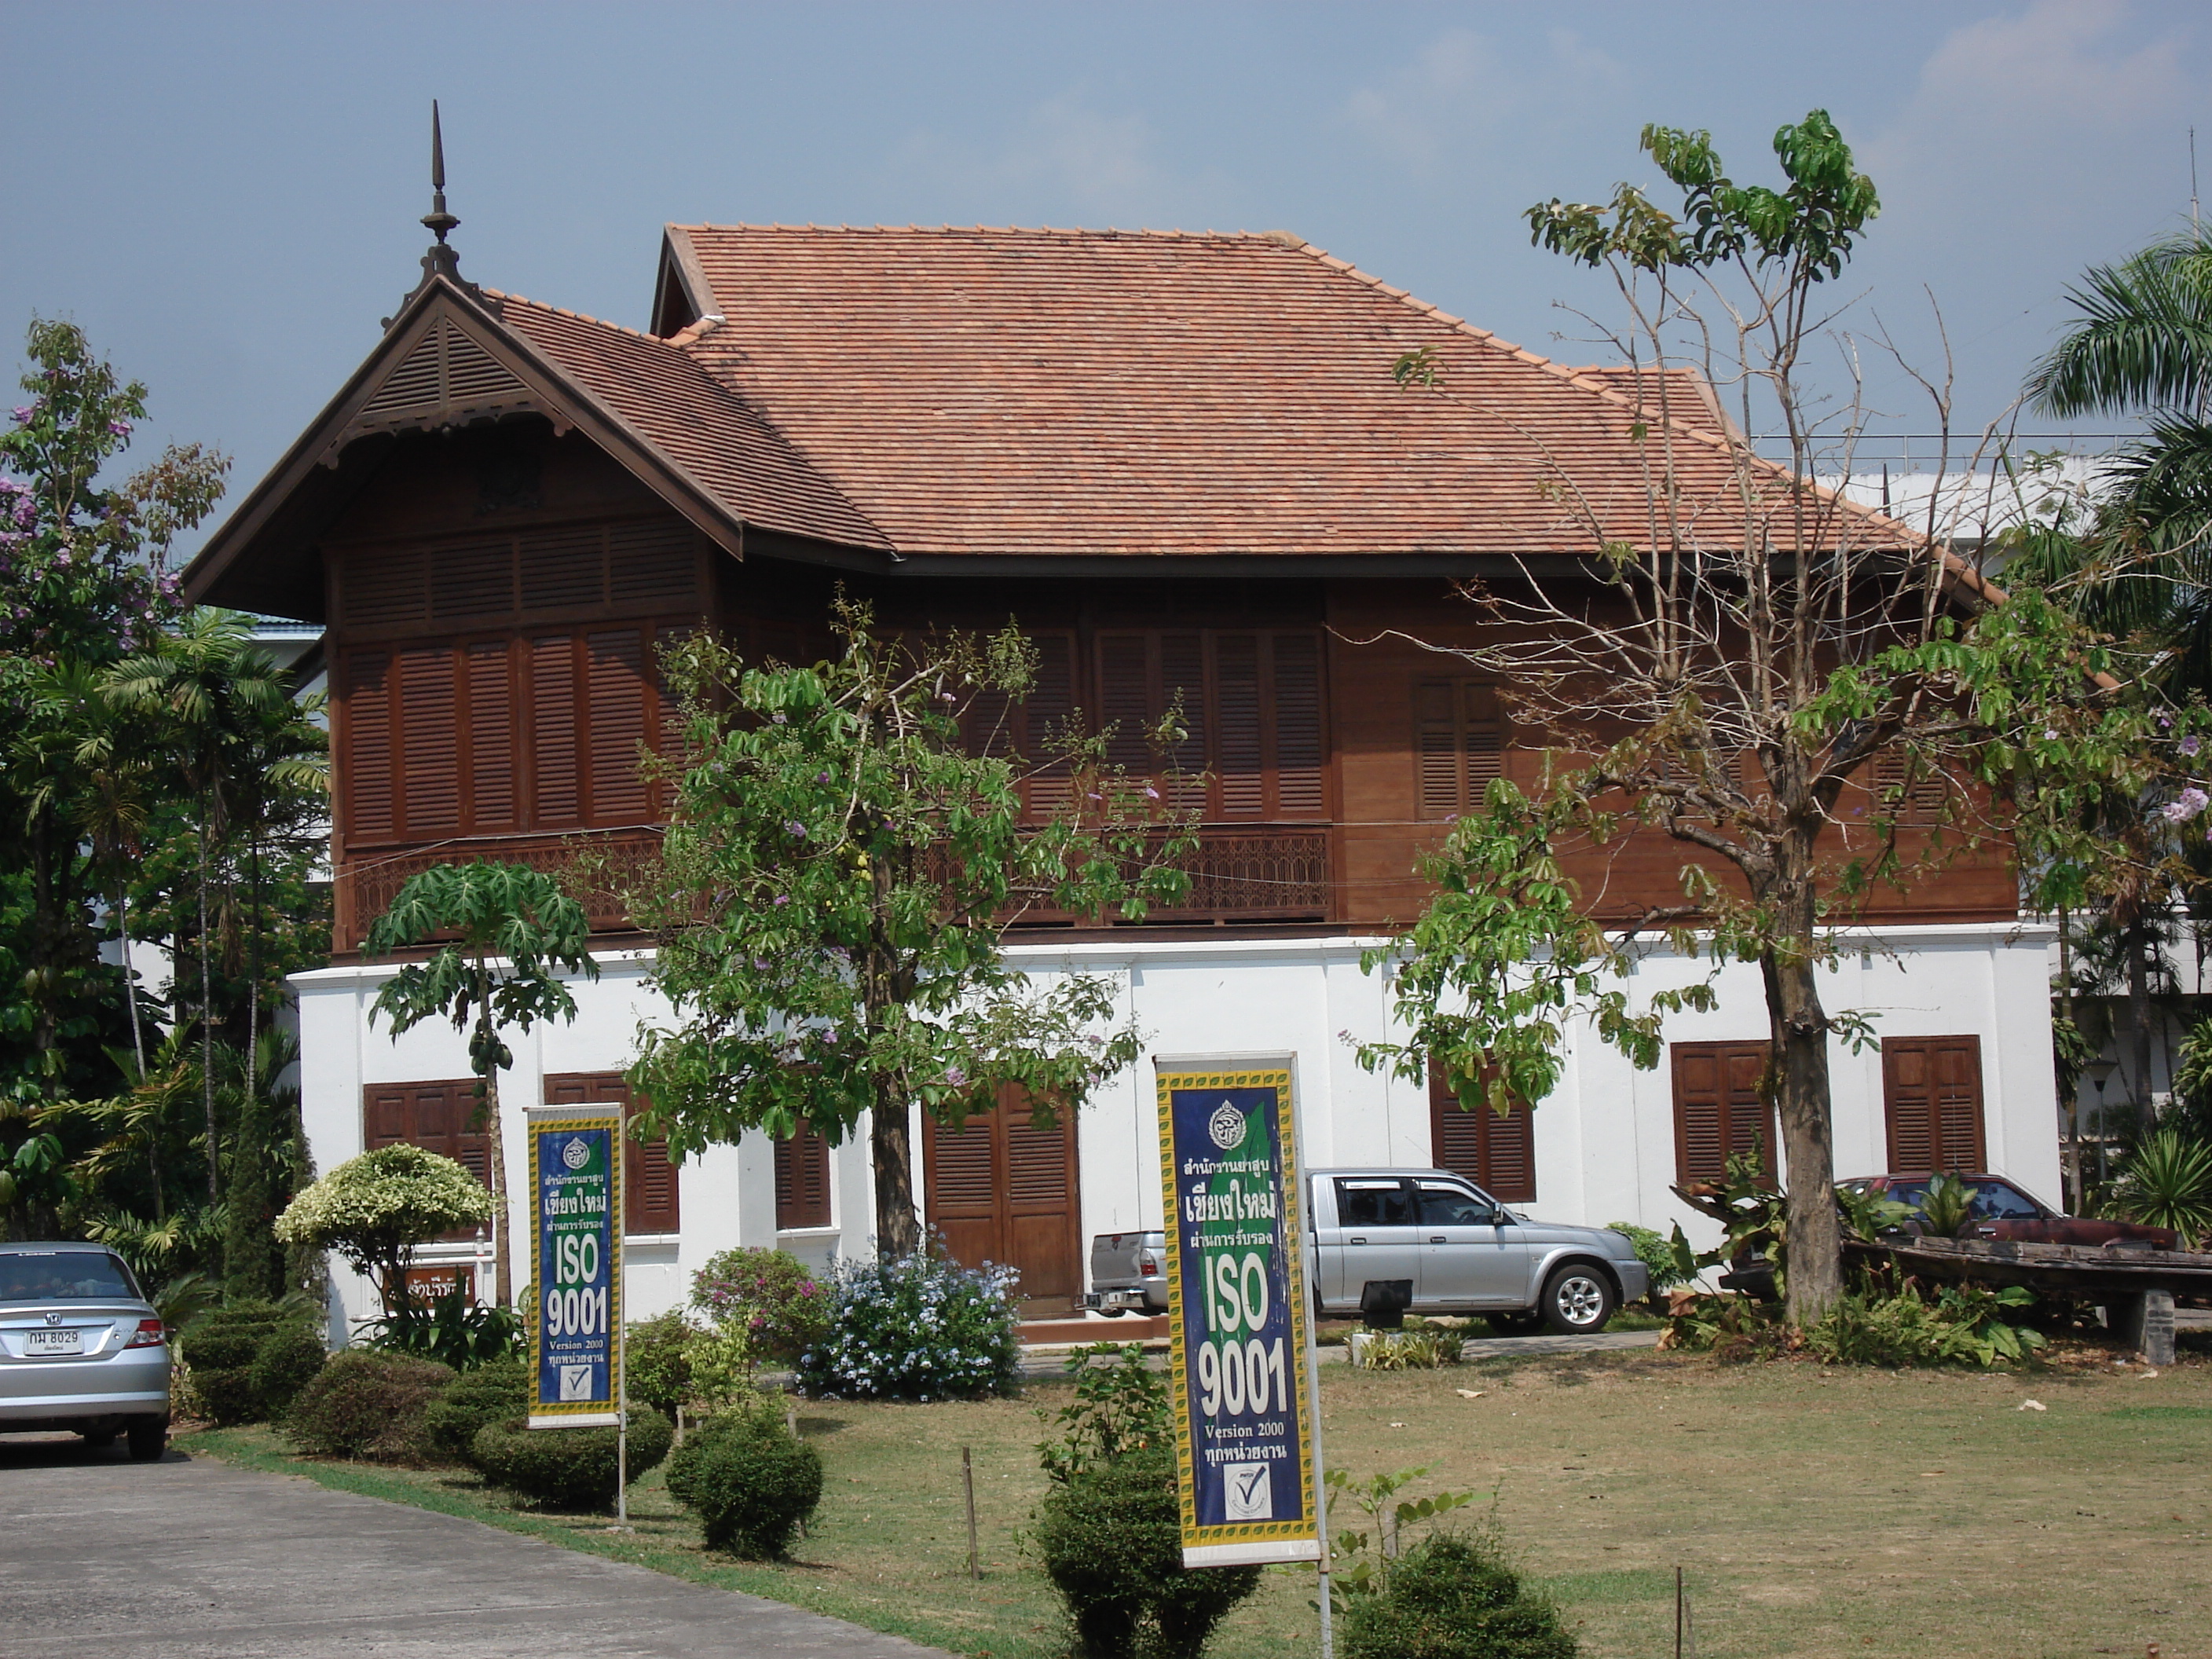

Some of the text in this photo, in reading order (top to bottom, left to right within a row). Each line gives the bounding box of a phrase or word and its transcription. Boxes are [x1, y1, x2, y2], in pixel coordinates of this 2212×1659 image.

[544, 1187, 606, 1216] เชียงใหม่
[1185, 1178, 1276, 1222] เชียงใหม่
[556, 1233, 599, 1284] ISO
[1205, 1252, 1269, 1332] ISO
[548, 1286, 607, 1336] 9001
[50, 1331, 78, 1343] 8029
[550, 1339, 603, 1350] Version 2000
[548, 1352, 604, 1368] ทุกหน่วยงาน
[1198, 1337, 1287, 1417] 9001
[1204, 1422, 1284, 1439] Version 2000
[1204, 1441, 1287, 1468] ทุกหน่วยงาน
